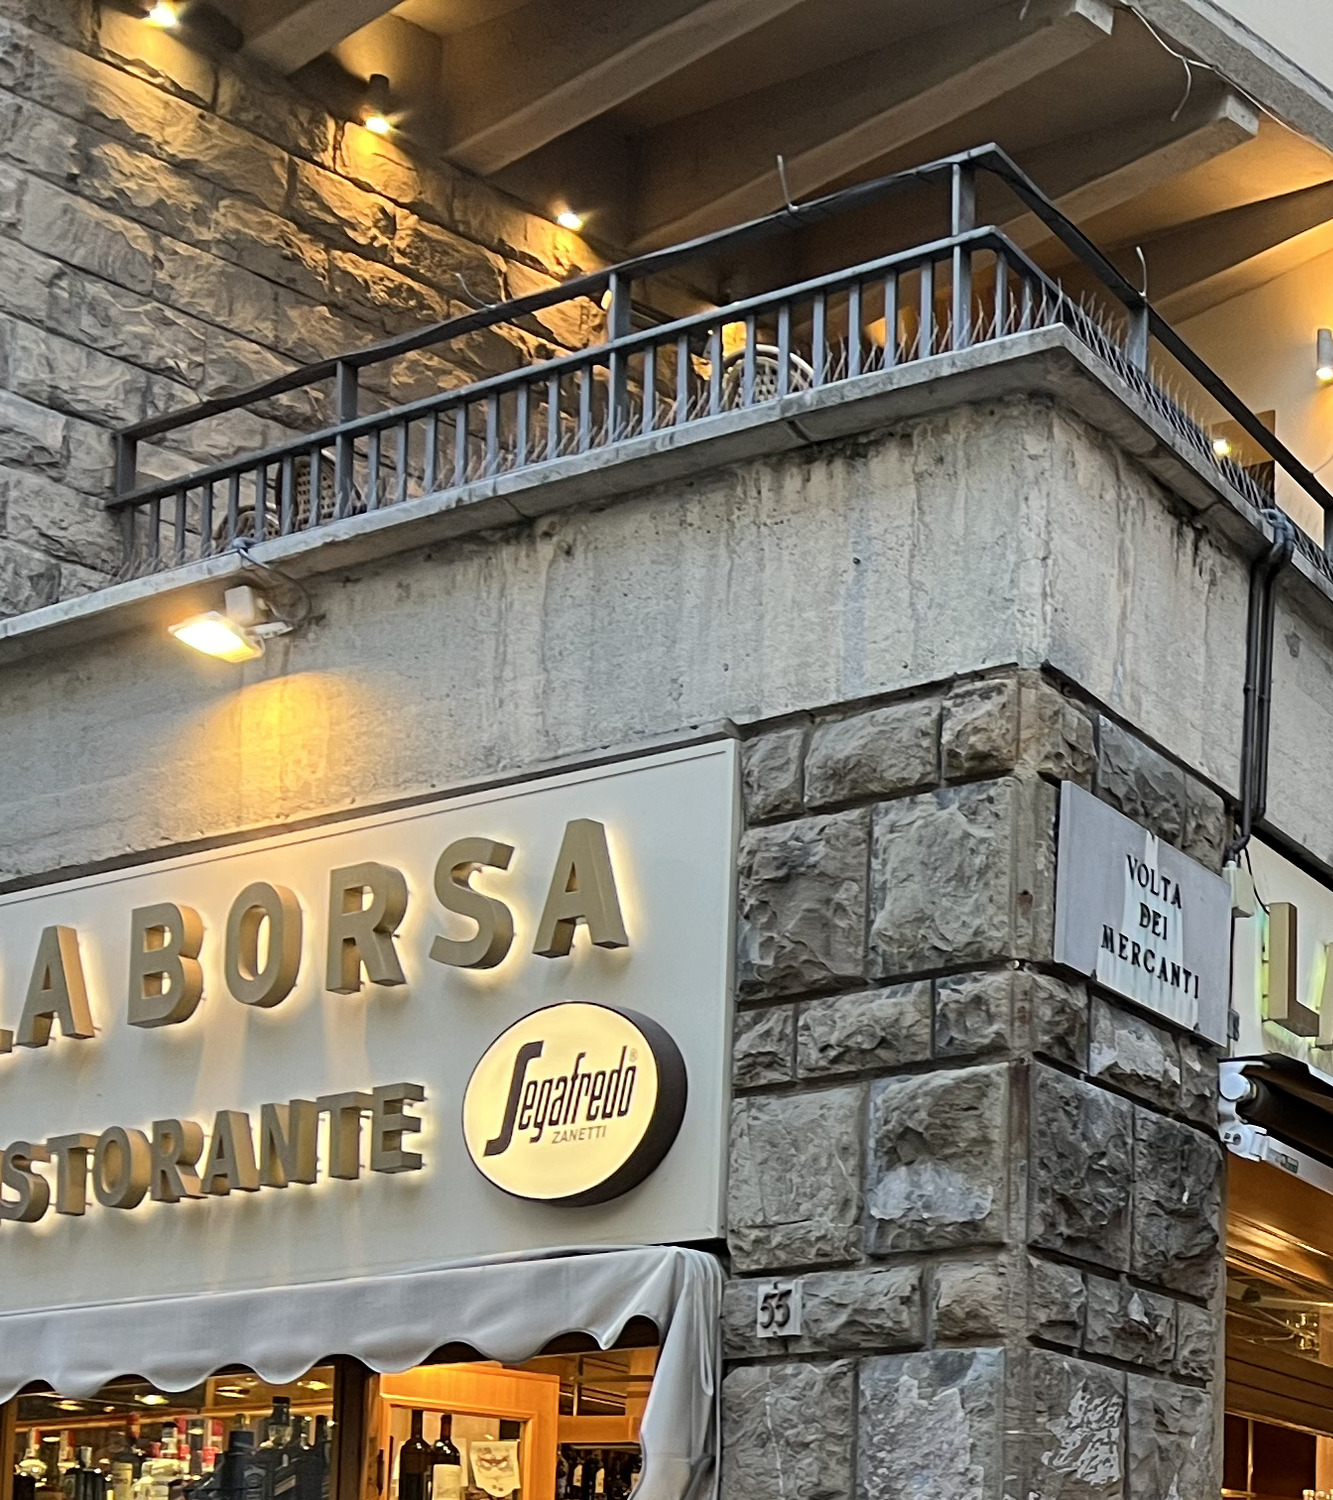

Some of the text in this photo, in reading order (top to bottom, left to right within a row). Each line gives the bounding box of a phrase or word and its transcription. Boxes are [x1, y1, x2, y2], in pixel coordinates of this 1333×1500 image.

[1126, 853, 1182, 909] VOLTA
[0, 818, 628, 1053] A BORSA
[1139, 902, 1167, 941] DEI
[1100, 924, 1199, 999] MERCANTI
[483, 1040, 637, 1157] Segafredo
[551, 1125, 607, 1145] ZANETTI
[760, 1289, 792, 1329] 55
